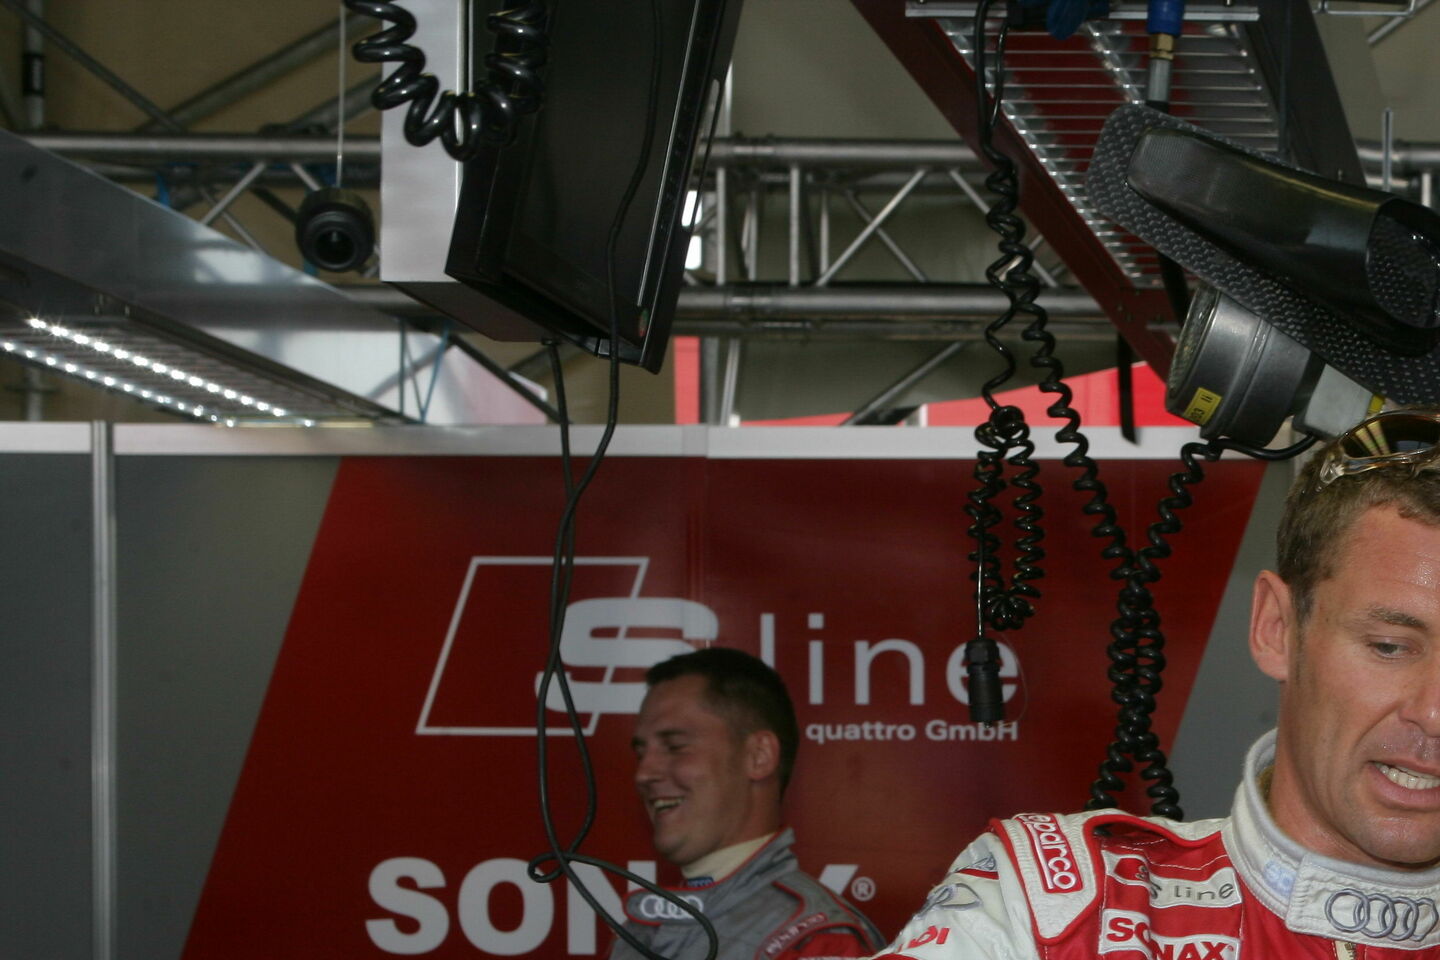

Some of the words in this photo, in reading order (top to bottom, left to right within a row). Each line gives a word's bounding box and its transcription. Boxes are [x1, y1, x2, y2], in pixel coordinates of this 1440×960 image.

[534, 597, 719, 714] S
[760, 613, 1019, 705] line
[805, 721, 916, 745] quattro
[925, 720, 1018, 742] GmbH
[1174, 883, 1234, 900] line
